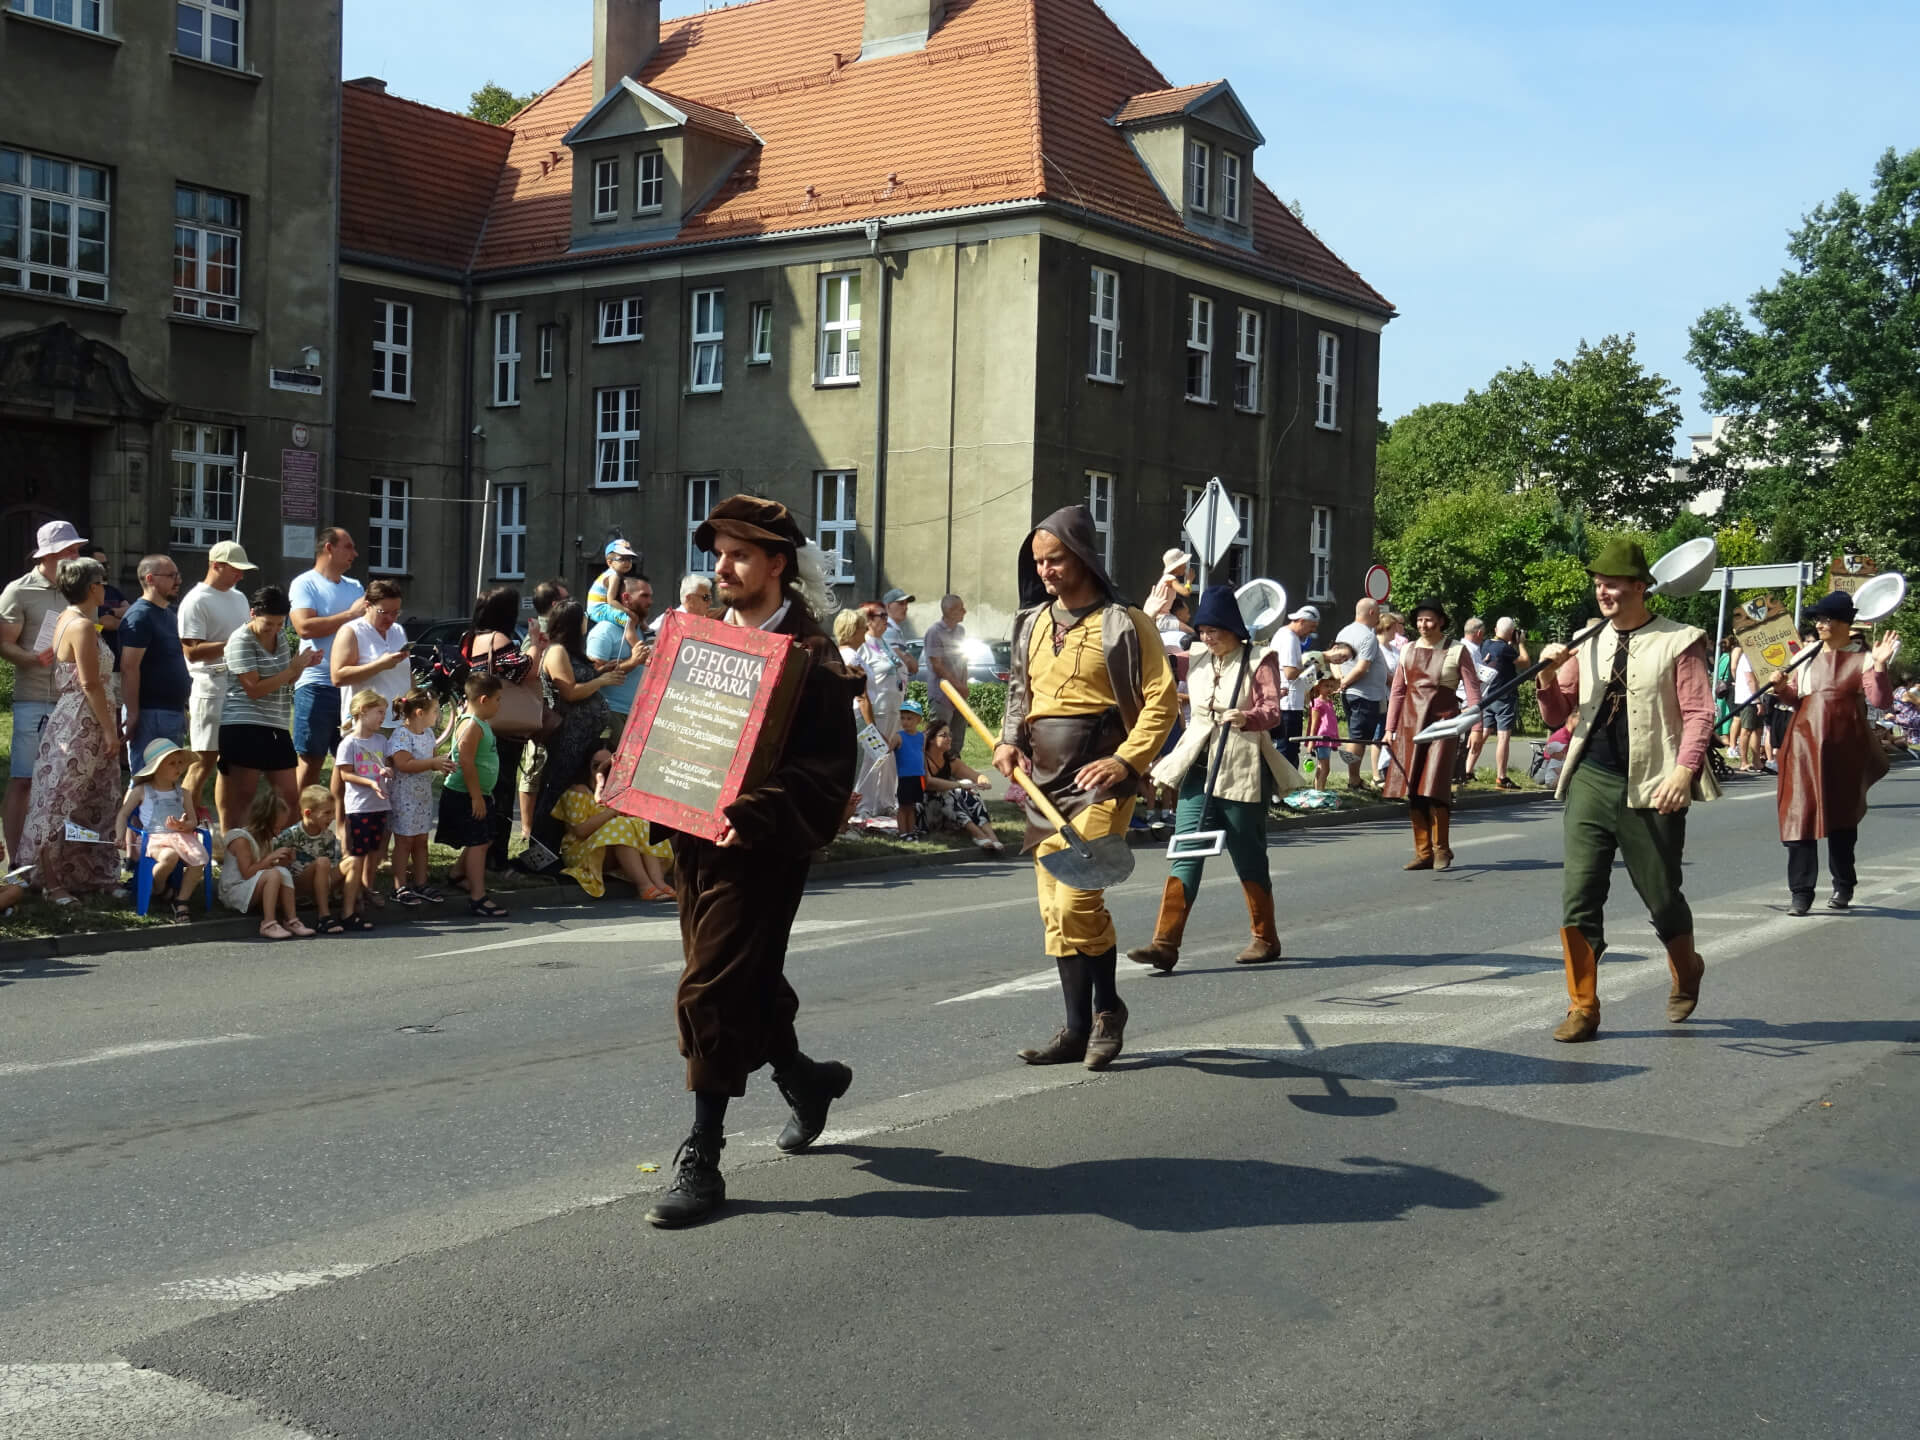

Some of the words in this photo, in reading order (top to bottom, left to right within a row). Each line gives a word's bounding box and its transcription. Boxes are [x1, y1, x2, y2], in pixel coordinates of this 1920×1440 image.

[1745, 632, 1766, 647] Cech
[681, 645, 763, 682] OFFICINA
[686, 667, 751, 698] FERRARIA
